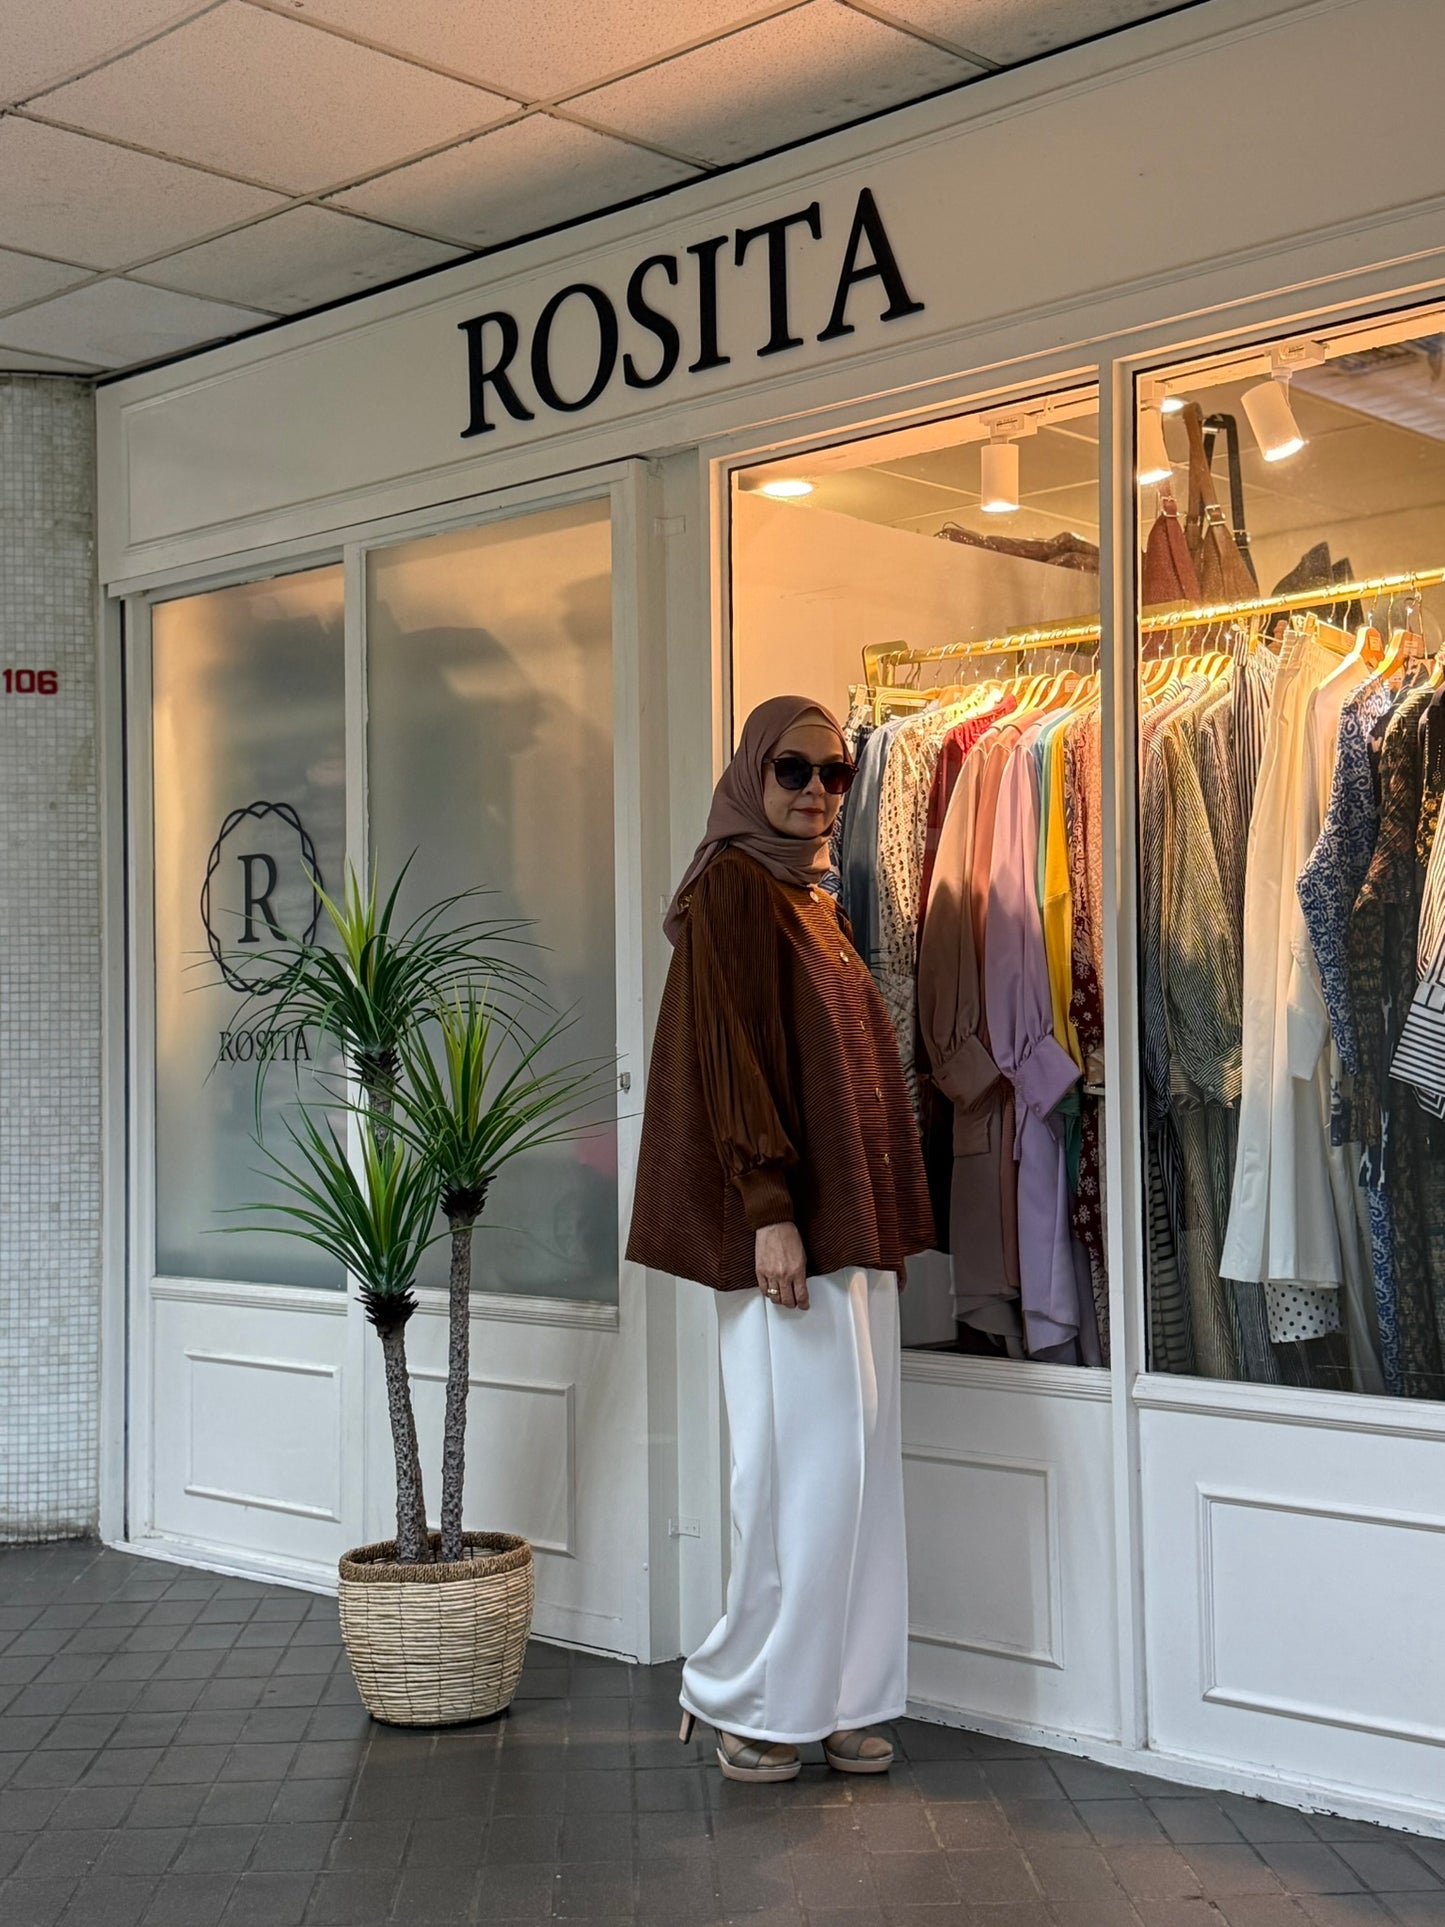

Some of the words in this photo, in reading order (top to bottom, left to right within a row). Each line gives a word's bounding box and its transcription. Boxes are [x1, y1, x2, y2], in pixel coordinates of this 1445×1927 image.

[457, 187, 925, 438] ROSITA
[2, 668, 58, 695] 106
[237, 853, 288, 944] R
[219, 1026, 312, 1062] ROSITA
